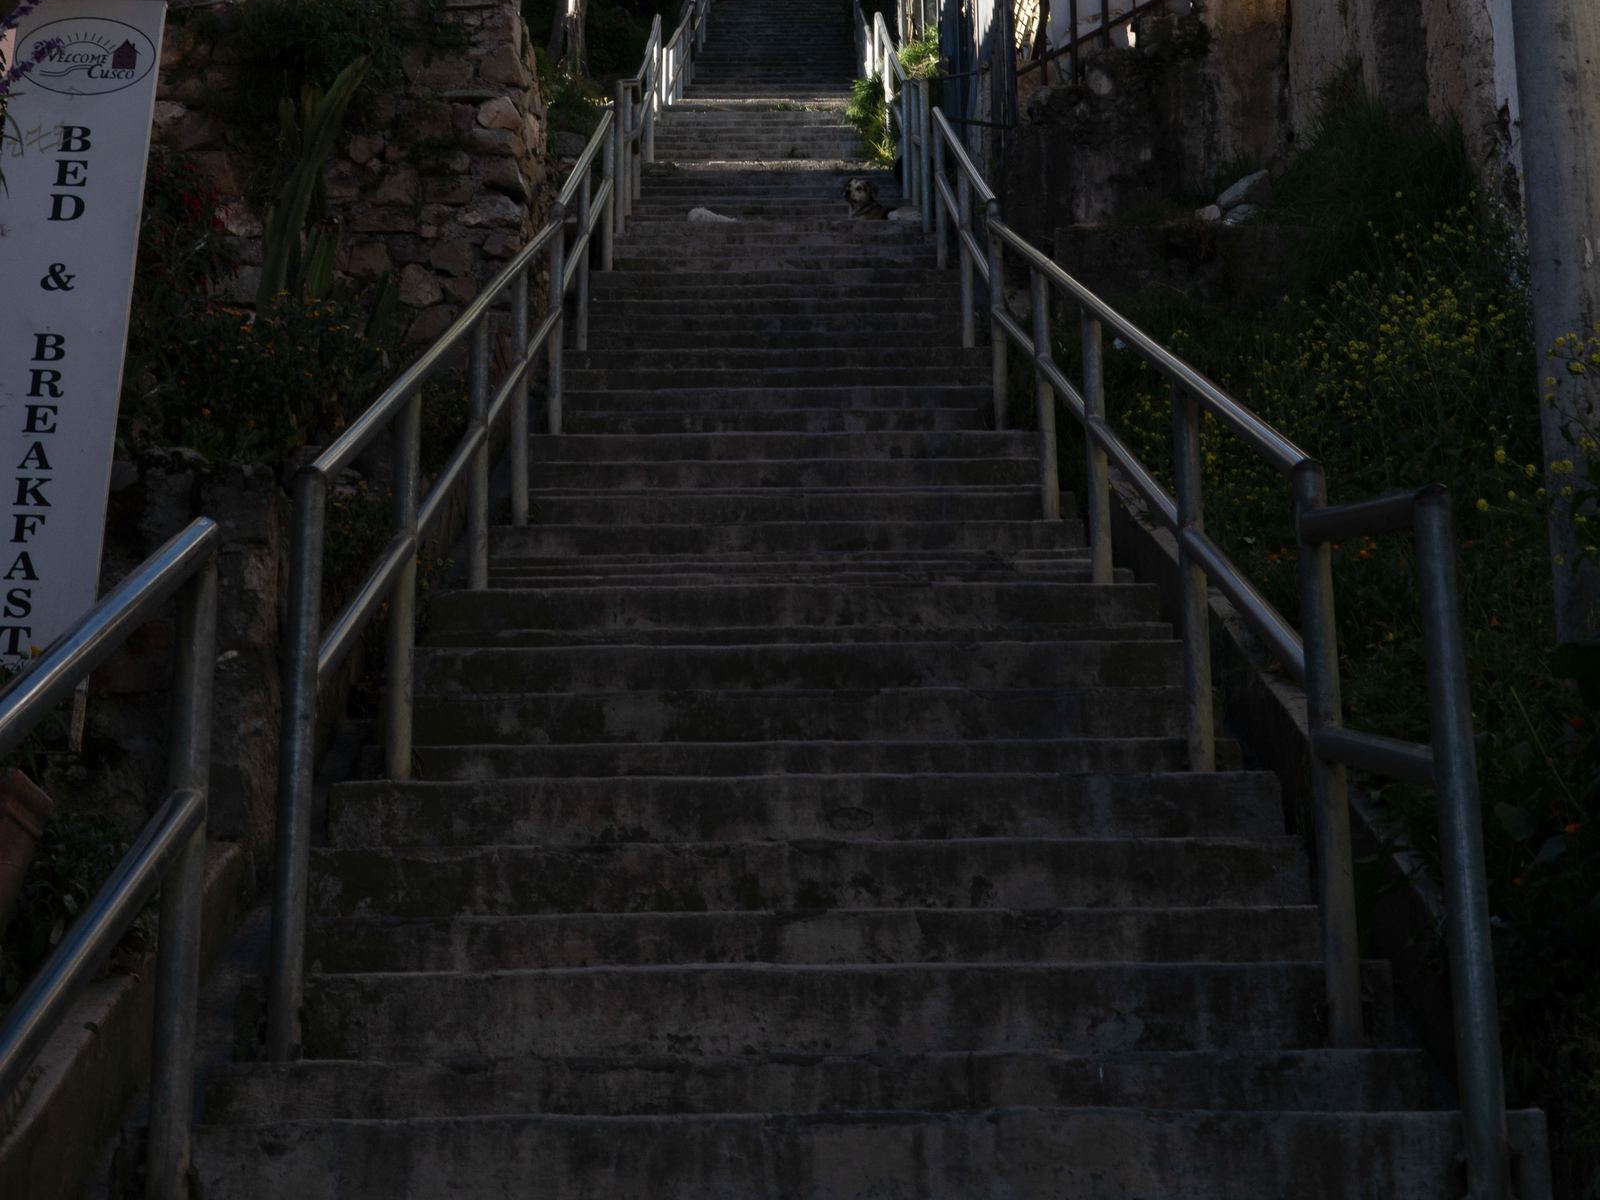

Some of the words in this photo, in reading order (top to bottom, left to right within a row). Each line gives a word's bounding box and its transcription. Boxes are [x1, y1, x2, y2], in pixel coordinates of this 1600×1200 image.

[47, 125, 92, 221] BED
[40, 263, 76, 291] &
[0, 333, 66, 655] BREAKFAST
